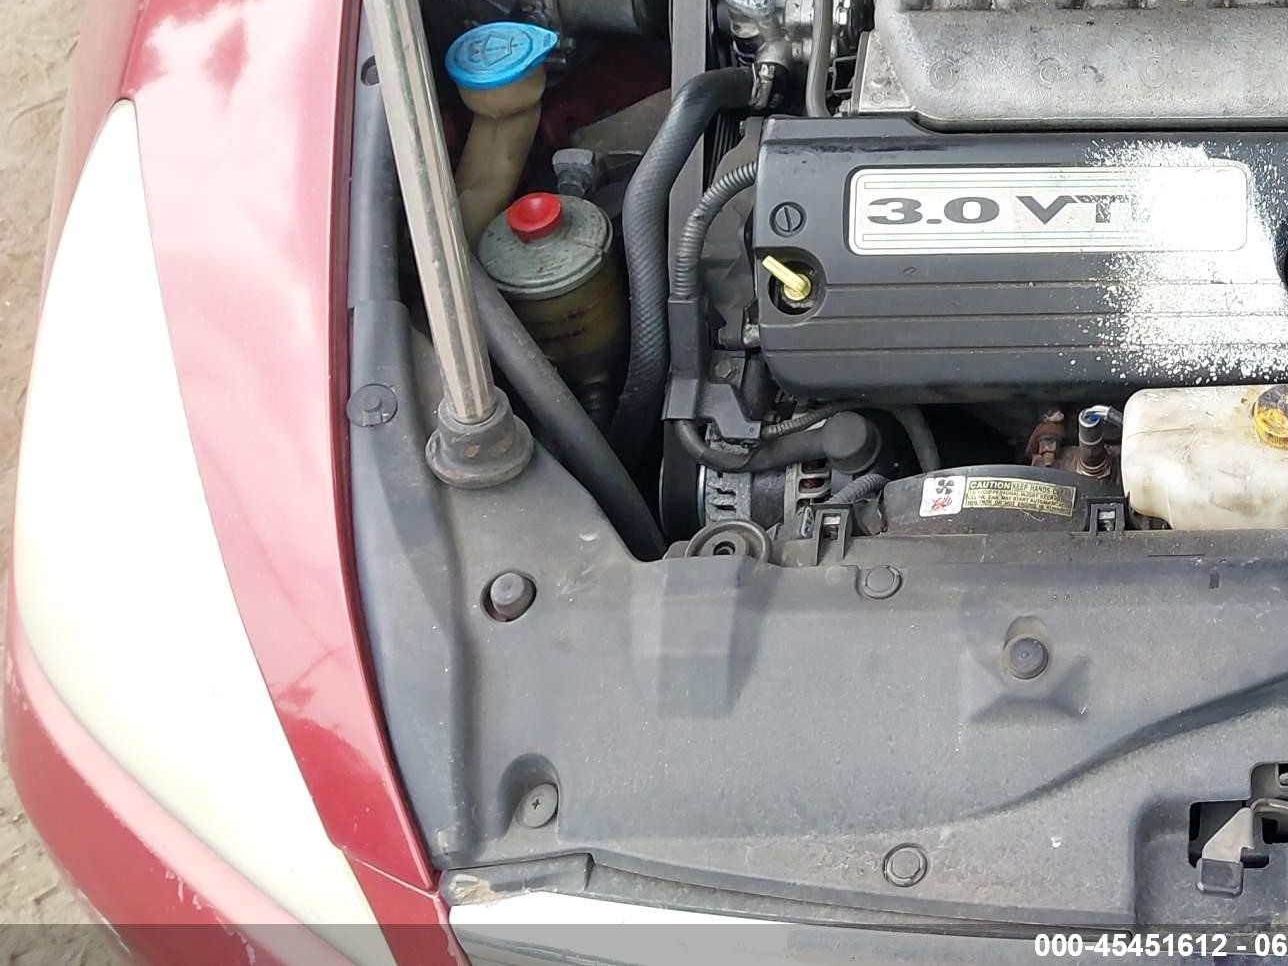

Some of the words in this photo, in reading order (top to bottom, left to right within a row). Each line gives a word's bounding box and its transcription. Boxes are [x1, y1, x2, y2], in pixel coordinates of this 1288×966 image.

[867, 196, 1000, 225] 3.0
[1015, 195, 1150, 224] VT
[970, 481, 1012, 490] CAUTION
